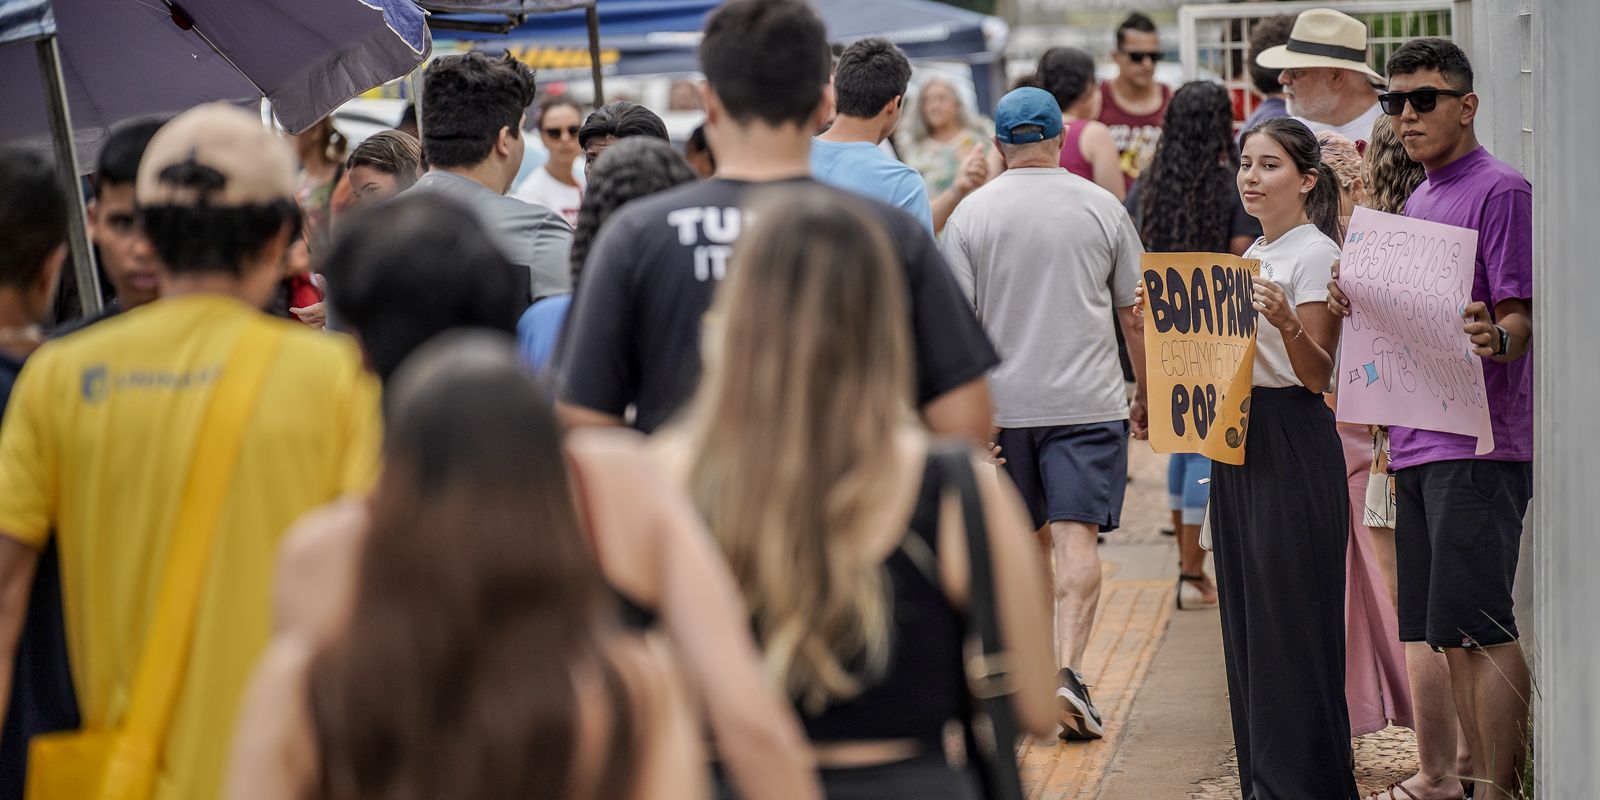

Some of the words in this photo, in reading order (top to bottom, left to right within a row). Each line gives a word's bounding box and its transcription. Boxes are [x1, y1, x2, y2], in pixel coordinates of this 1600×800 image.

[667, 206, 757, 246] TU
[1355, 230, 1462, 296] ESTAMOS
[1144, 266, 1214, 335] BOA
[1399, 289, 1463, 352] PARA
[1161, 339, 1223, 379] ESTAMOS
[1372, 336, 1417, 393] TE
[1171, 383, 1217, 440] POR
